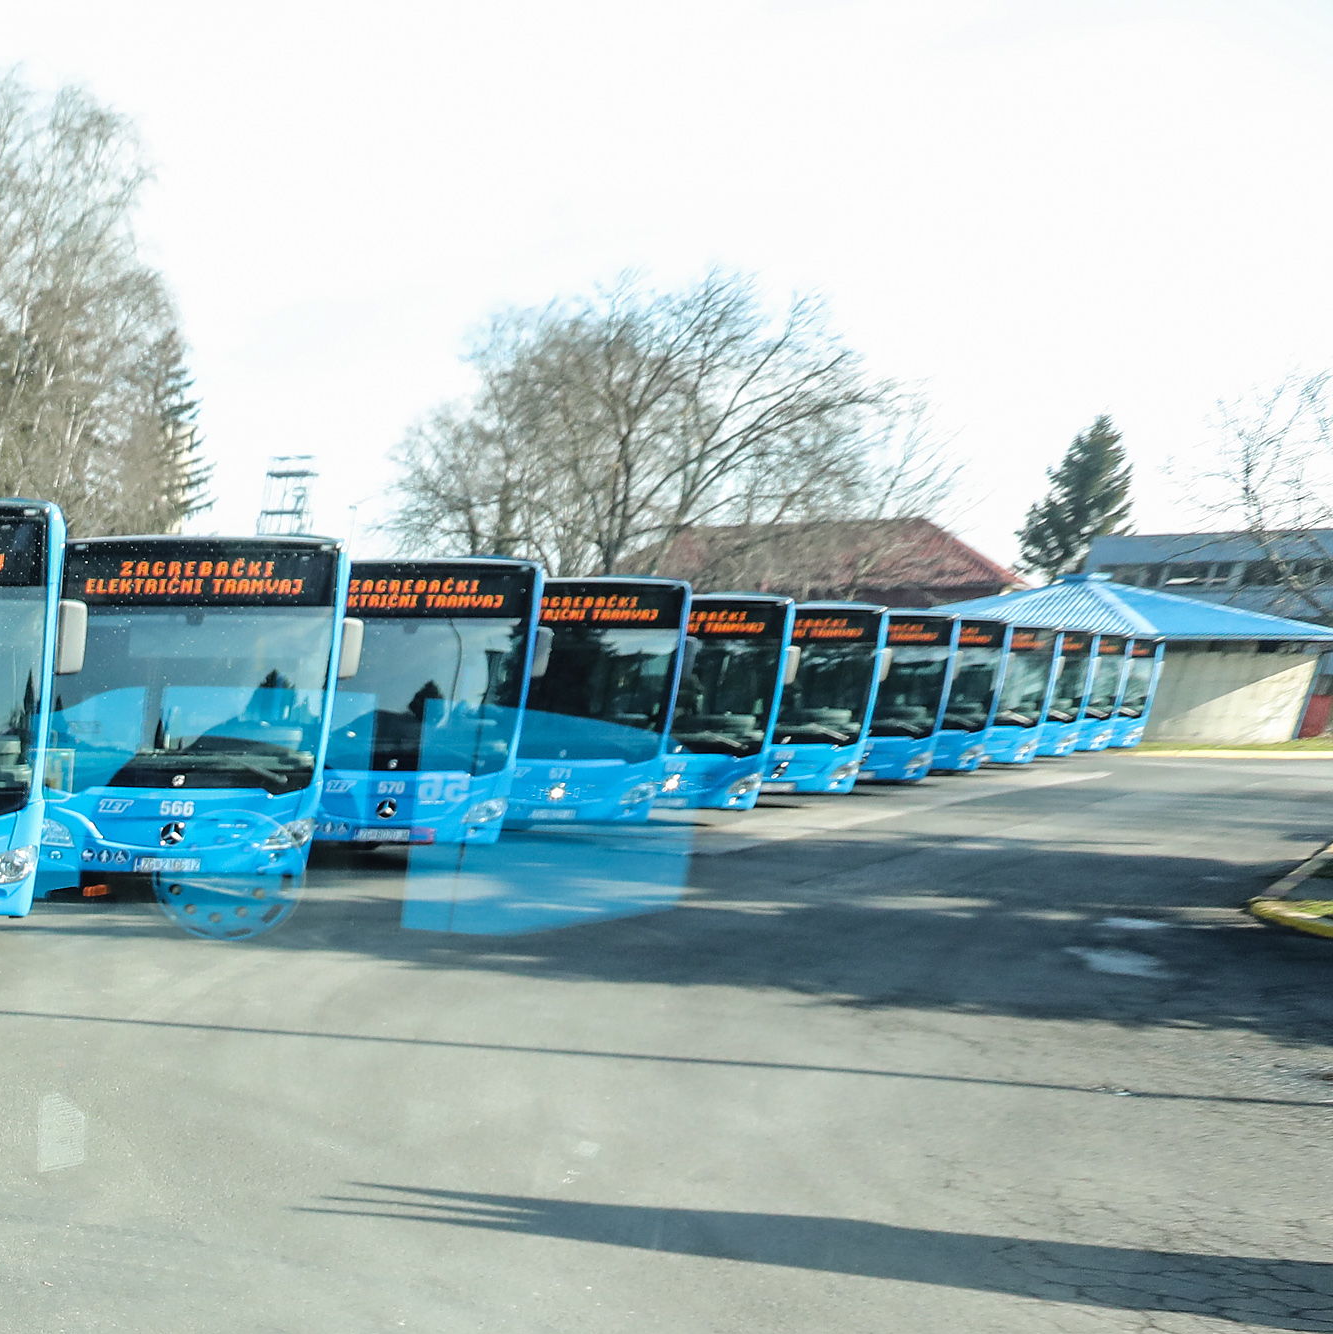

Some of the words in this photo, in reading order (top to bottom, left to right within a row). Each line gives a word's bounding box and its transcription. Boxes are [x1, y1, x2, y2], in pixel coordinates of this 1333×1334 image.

[119, 558, 276, 578] ZAGREBAČKI
[85, 576, 204, 595] ELEKTRIČNI
[211, 578, 304, 595] TRAMVAJ
[348, 577, 481, 594] ZAGREBAČKI
[346, 592, 419, 609] KTRIČNI
[425, 594, 505, 609] TRAMVAJ
[540, 594, 640, 609] AGREBAČKI
[377, 781, 406, 795] 570
[99, 799, 134, 814] ZET
[159, 800, 195, 816] 566
